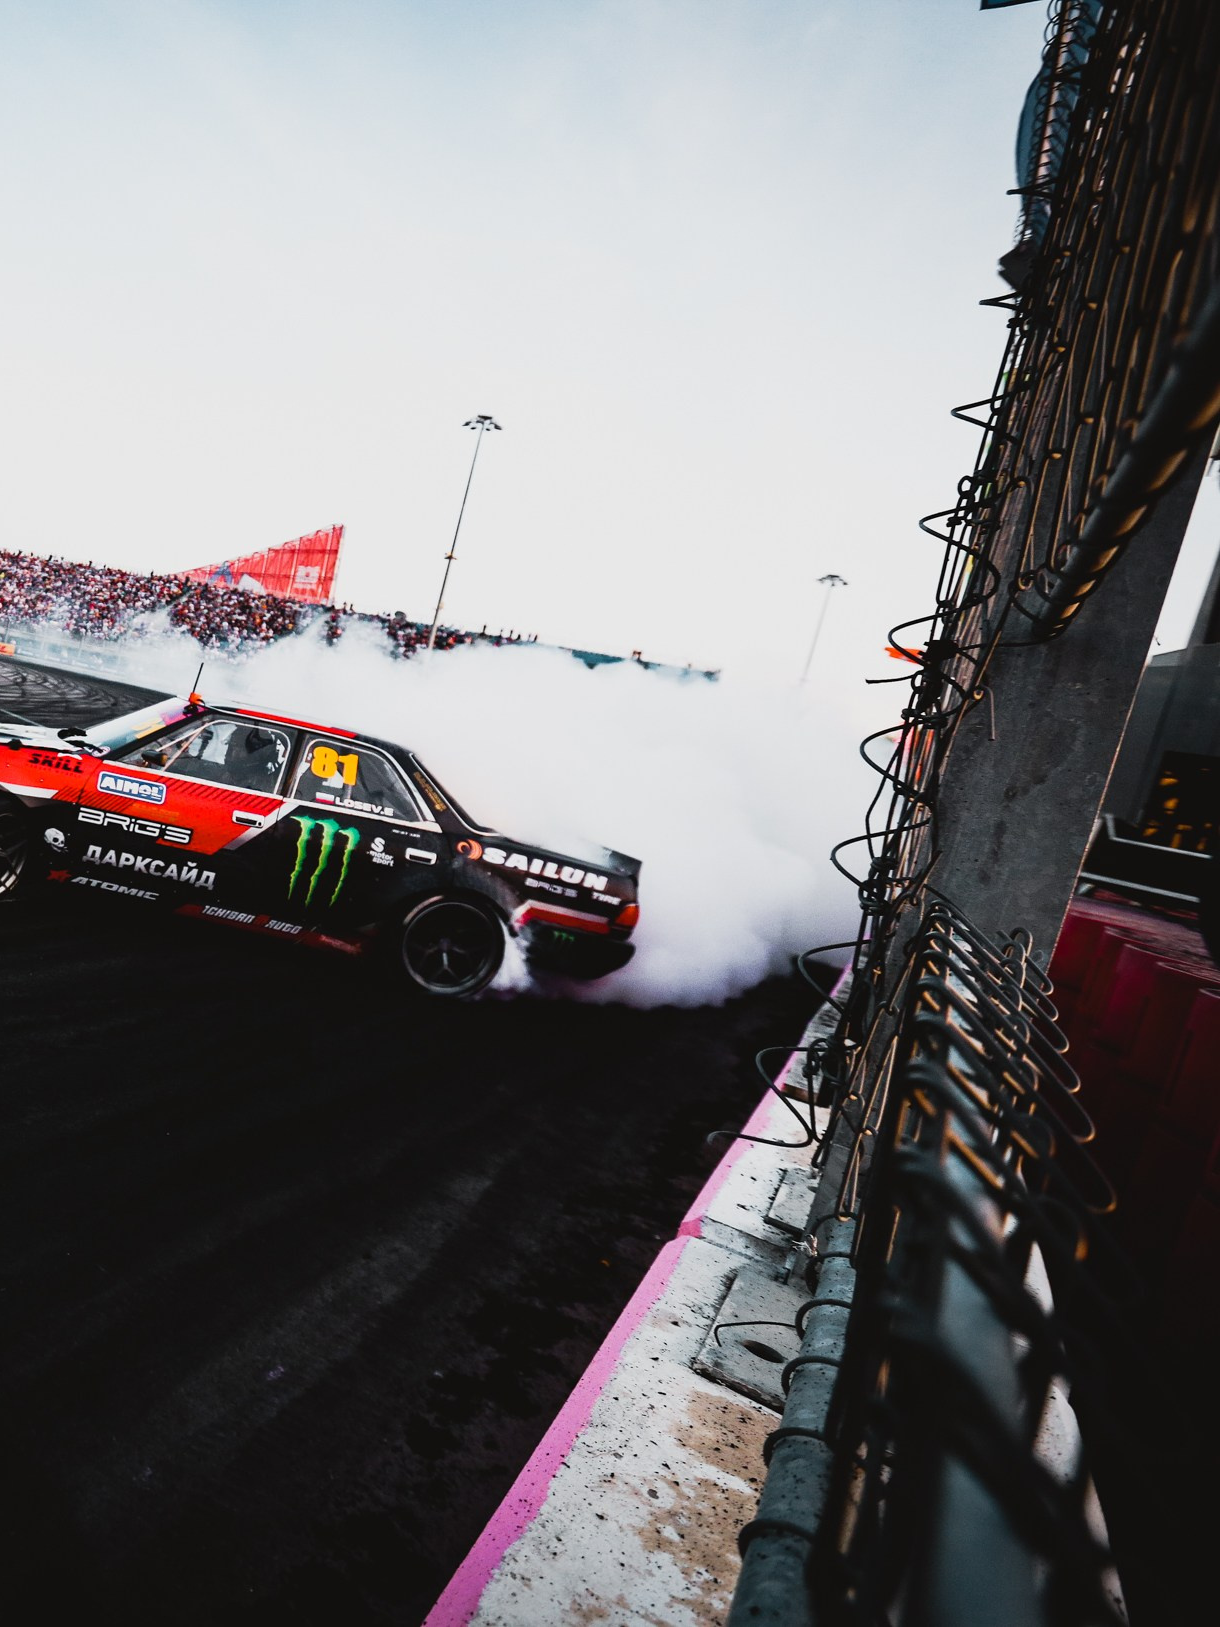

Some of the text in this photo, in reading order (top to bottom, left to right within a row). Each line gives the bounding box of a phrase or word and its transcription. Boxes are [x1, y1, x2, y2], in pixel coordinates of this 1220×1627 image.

[311, 746, 359, 786] 81
[100, 776, 162, 800] AIMOL
[82, 844, 216, 891] ДАРКСАЙД
[482, 847, 609, 891] SAILUN
[71, 876, 160, 900] ATOMIC
